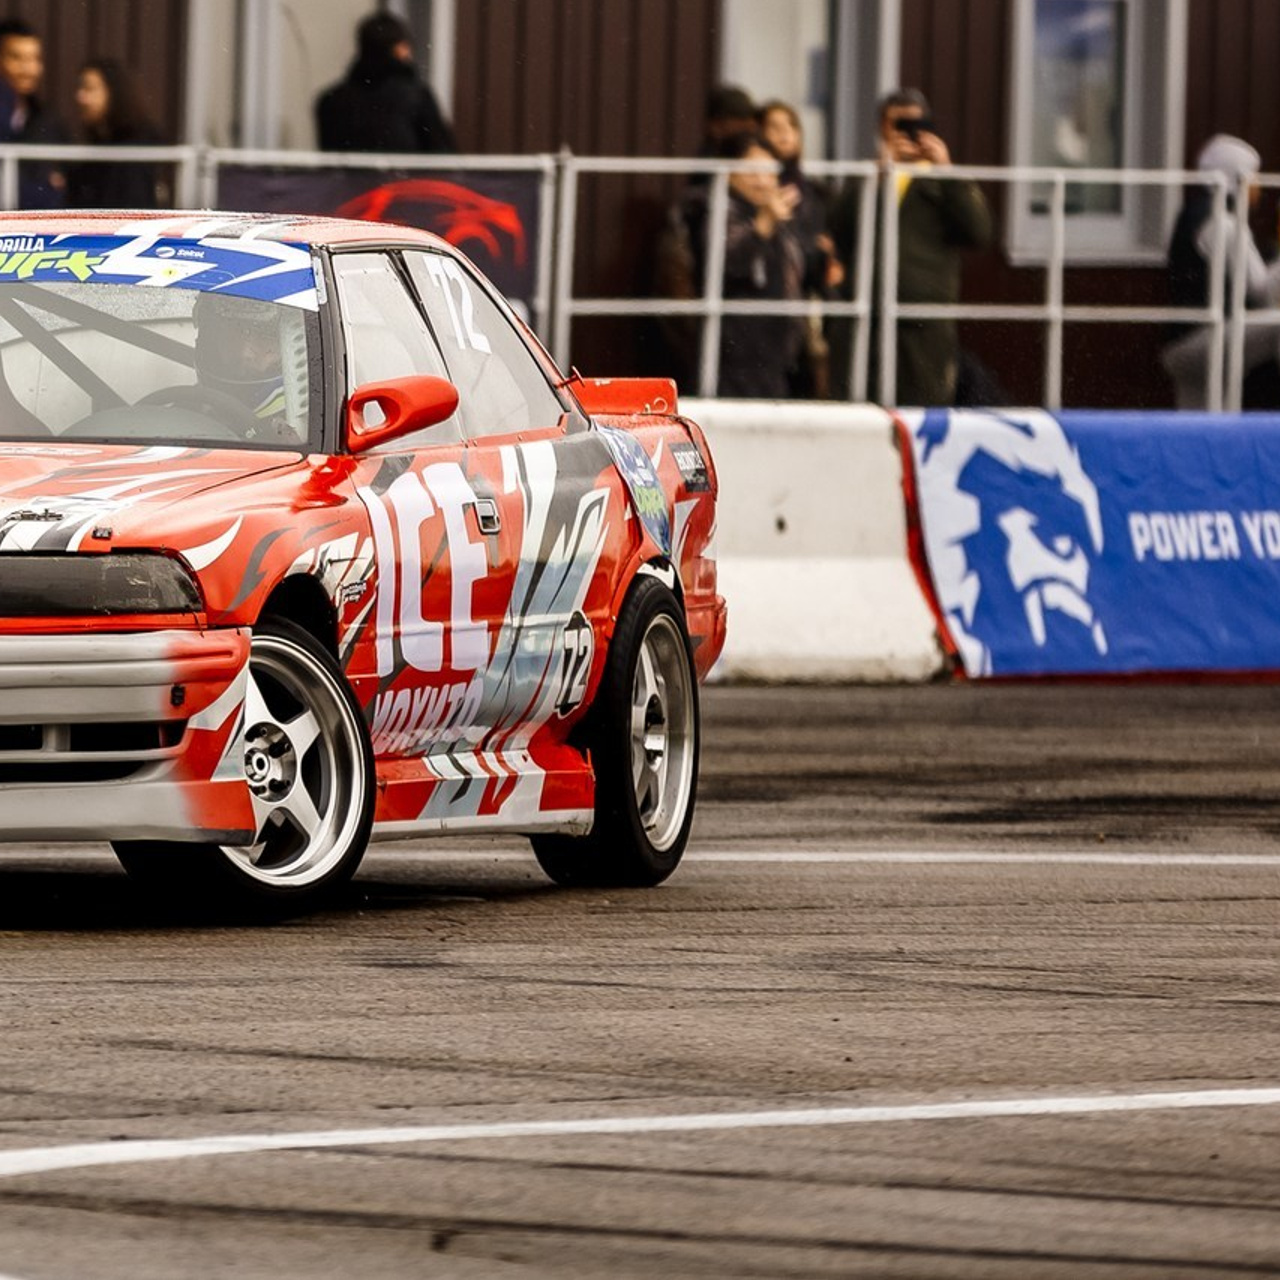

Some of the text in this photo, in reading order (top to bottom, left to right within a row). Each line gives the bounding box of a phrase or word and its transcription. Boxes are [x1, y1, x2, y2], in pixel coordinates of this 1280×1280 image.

[422, 255, 493, 354] 72
[357, 462, 489, 677] ICE
[1128, 510, 1241, 562] POWER
[556, 627, 592, 705] 72
